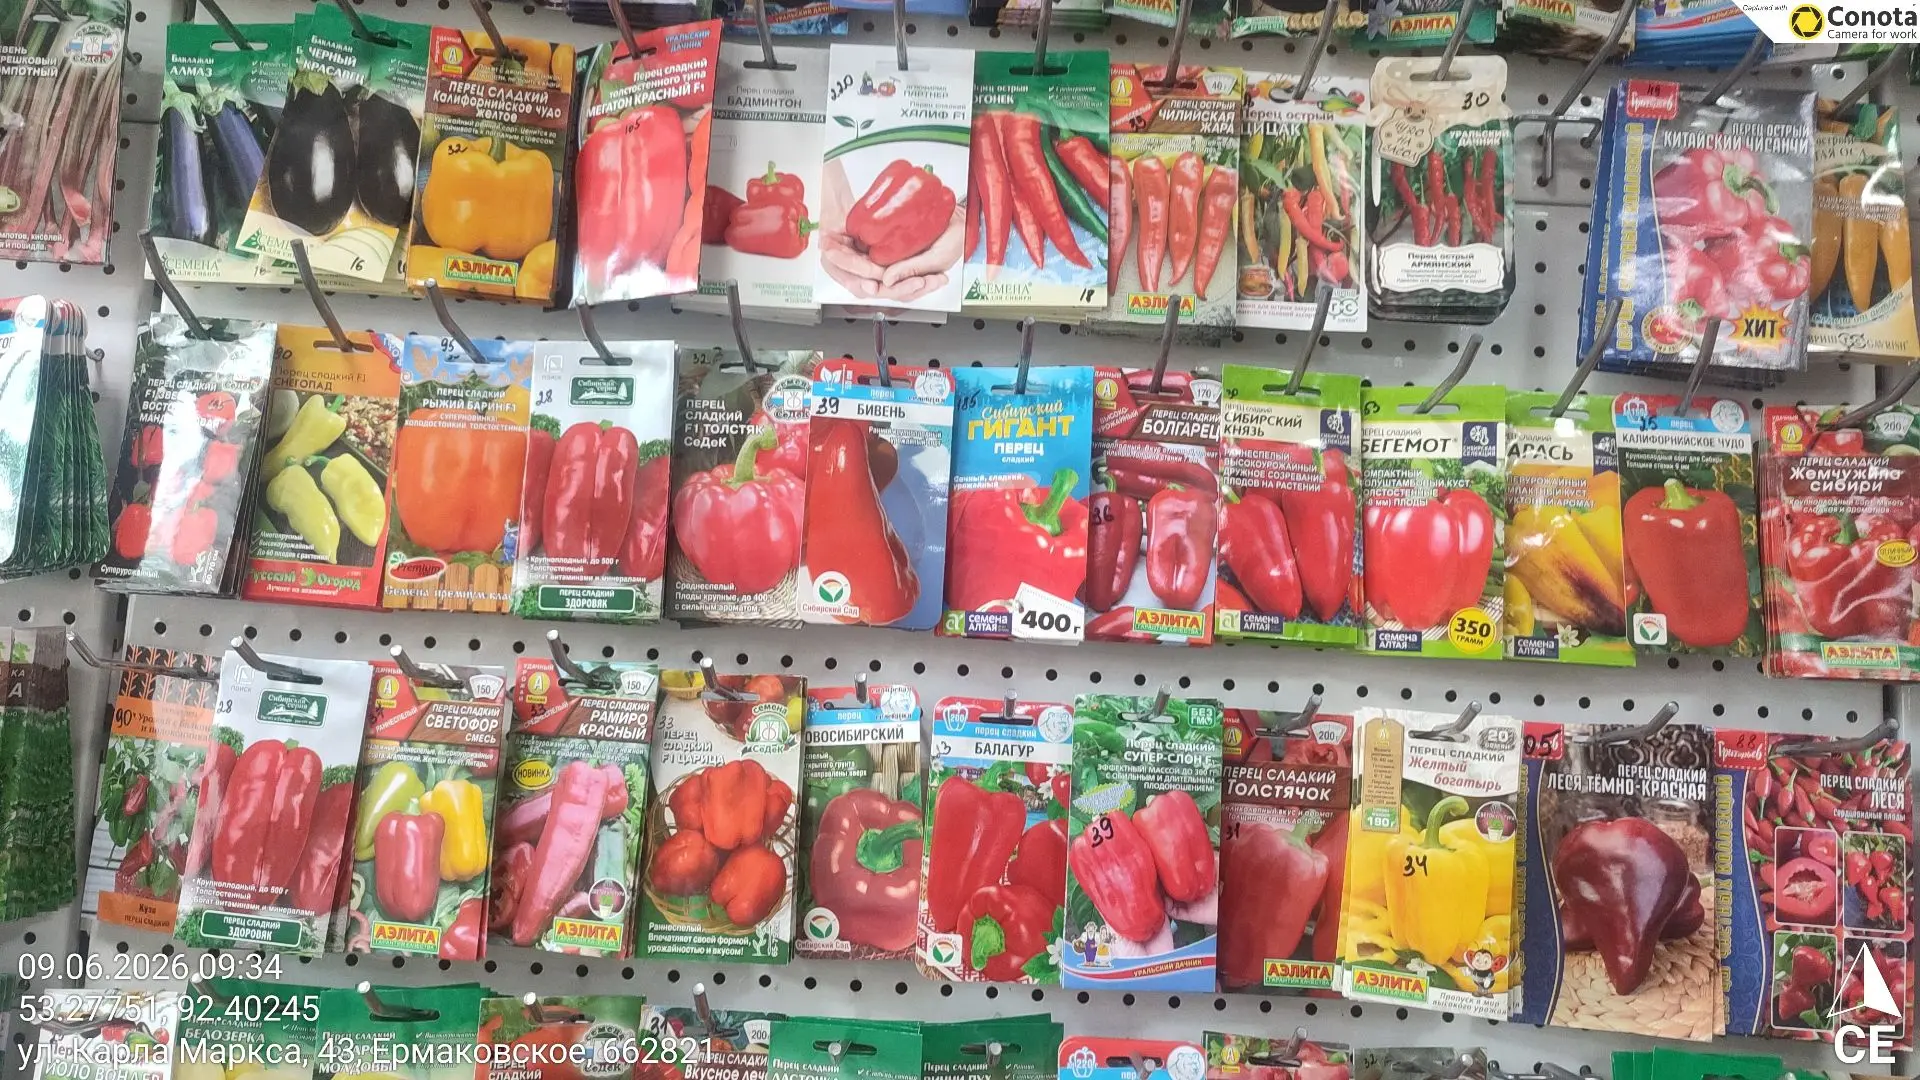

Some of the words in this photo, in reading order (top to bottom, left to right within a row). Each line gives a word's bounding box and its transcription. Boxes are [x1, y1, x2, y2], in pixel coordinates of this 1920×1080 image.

[665, 30, 710, 43] УРАЛЬСКИЙ
[671, 40, 702, 53] ДАЧНИК
[0, 55, 56, 65] РЕШКОВЫЙ
[170, 66, 212, 76] АЛМАЗ
[303, 59, 364, 84] КРАСАВЕЦ
[634, 69, 663, 82] Перец
[665, 59, 707, 74] сладкий
[449, 81, 484, 96] ПЕРЕЦ
[488, 86, 548, 104] СЛАДКИЙ
[586, 97, 633, 118] МЕГАТОН
[634, 85, 691, 106] КРАСНЫЙ
[693, 83, 705, 93] F1
[727, 96, 801, 109] БАДМИНТОН
[1171, 100, 1199, 110] ПЕРЕЦ
[1200, 101, 1236, 110] ОСТРЫЙ
[536, 106, 562, 119] чудо
[901, 109, 948, 120] ХАЛИФ
[953, 112, 965, 120] F1
[1159, 109, 1235, 122] ЧИЛИЙСКАЯ
[1200, 122, 1234, 134] ЖАРА
[1450, 129, 1509, 138] УРАЛЬСКИЙ
[1732, 123, 1764, 136] ПЕРЕЦ
[1767, 124, 1809, 137] ОСТРЫЙ
[1458, 139, 1500, 147] ДАЧНИК
[1664, 129, 1742, 150] КИТАЙСКИЙ
[449, 261, 511, 277] АЭЛИТА
[1744, 319, 1778, 338] ХИТ
[437, 388, 467, 398] ПЕРЕЦ
[470, 389, 505, 399] СЛАДКИЙ
[423, 399, 464, 410] РЫЖИЙ
[466, 400, 504, 411] БАРИН
[505, 403, 517, 412] F1
[686, 399, 726, 410] ПЕРЕЦ
[816, 397, 840, 414] 39
[856, 404, 906, 418] БИВЕНЬ
[982, 399, 1064, 421] Сибирский
[685, 410, 743, 423] СЛАДКИЙ
[1153, 408, 1178, 419] ПЕРЕЦ
[1180, 411, 1221, 423] СЛАДКИЙ
[1224, 412, 1302, 427] СИБИРСКИЙ
[685, 423, 700, 434] F1
[703, 423, 764, 435] ТОЛСТЯК
[968, 416, 1075, 440] ГИГАНТ
[1142, 420, 1220, 441] БОЛГАРЕЦ
[1224, 426, 1264, 436] КНЯЗЬ
[1360, 438, 1450, 453] БЕГЕМОТ
[1622, 433, 1715, 448] КАЛИФОРНИЙСКОЕ
[1717, 438, 1744, 449] ЧУДО
[994, 442, 1044, 456] ПЕРЕЦ
[1800, 457, 1833, 466] ПЕРЕЦ
[1835, 456, 1890, 467] СЛАДКИЙ
[1810, 479, 1884, 493] сибири
[559, 589, 581, 598] ПЕРЕЦ
[583, 589, 615, 597] СЛАДКИЙ
[565, 598, 608, 608] ЗДОРОВЯК
[803, 603, 842, 614] Сибирский
[844, 606, 858, 617] Сад
[968, 623, 998, 632] АЛТАЯ
[1021, 611, 1071, 632] 400
[1073, 625, 1081, 634] г
[1138, 614, 1200, 628] АЭЛИТА
[1243, 622, 1271, 631] АЛТАЯ
[1454, 617, 1491, 638] 350
[1379, 633, 1417, 642] семена
[1456, 636, 1484, 646] ГРАММ
[1517, 639, 1555, 649] семена
[1379, 641, 1408, 649] АЛТАЯ
[1517, 648, 1546, 657] АЛТАЯ
[432, 703, 460, 714] ПЕРЕЦ
[462, 705, 500, 717] СЛАДКИЙ
[580, 698, 603, 709] ПЕРЕЦ
[606, 701, 651, 713] СЛАДКИЙ
[425, 715, 498, 731] СВЕТОФОР
[590, 710, 649, 725] РАМИРО
[465, 733, 497, 743] СМЕСЬ
[578, 723, 647, 740] КРАСНЫЙ
[663, 730, 697, 742] ПЕРЕЦ
[662, 742, 713, 753] СЛАДКИЙ
[974, 742, 1035, 758] БАЛАГУР
[1126, 739, 1164, 751] Перец
[1166, 740, 1215, 752] сладкий
[661, 754, 675, 764] F1
[677, 754, 725, 765] ЦАРИЦА
[1124, 751, 1199, 764] СУПЕР-СЛОН
[1410, 745, 1445, 757] ПЕРЕЦ
[1449, 750, 1505, 762] СЛАДКИЙ
[1408, 757, 1468, 773] Желтый
[518, 768, 552, 781] НОВИНКА
[1223, 766, 1263, 781] ПЕРЕЦ
[1267, 770, 1334, 786] СЛАДКИЙ
[1618, 764, 1651, 780] ПЕРЕЦ
[1655, 768, 1707, 783] СЛАДКИЙ
[1144, 782, 1215, 792] ПЛОДОНОШЕНИЕМ!
[1434, 772, 1502, 792] богатырь
[1547, 773, 1581, 791] ЛЕСЯ
[1587, 775, 1706, 801] ТЁМНО-КРАСНАЯ
[1820, 773, 1852, 790] ПЕРЕЦ
[1855, 776, 1905, 793] СЛАДКИЙ
[1227, 780, 1332, 802] ТОЛСТЯЧОК
[1870, 792, 1905, 810] ЛЕСЯ
[1367, 816, 1390, 828] 180
[1391, 819, 1396, 829] г
[1091, 817, 1114, 848] 39
[1402, 855, 1428, 877] 34
[223, 916, 244, 925] ПЕРЕЦ
[246, 918, 280, 929] СЛАДКИЙ
[649, 922, 704, 933] Раннеспелый.
[228, 927, 272, 941] ЗДОРОВЯК
[375, 922, 437, 944] АЭЛИТА
[556, 922, 620, 941] АЭЛИТА
[648, 932, 692, 944] Впечатляет
[693, 935, 716, 943] своей
[718, 936, 751, 947] формой,
[796, 938, 834, 949] Сибирский
[836, 940, 850, 950] Сад
[648, 944, 704, 955] урожайностью
[712, 947, 744, 956] вкусом!
[1134, 960, 1173, 978] УРАЛЬСКИЙ
[1175, 959, 1203, 970] ДАЧНИК
[1268, 964, 1329, 980] АЭЛИТА
[1356, 973, 1424, 993] АЭЛИТА
